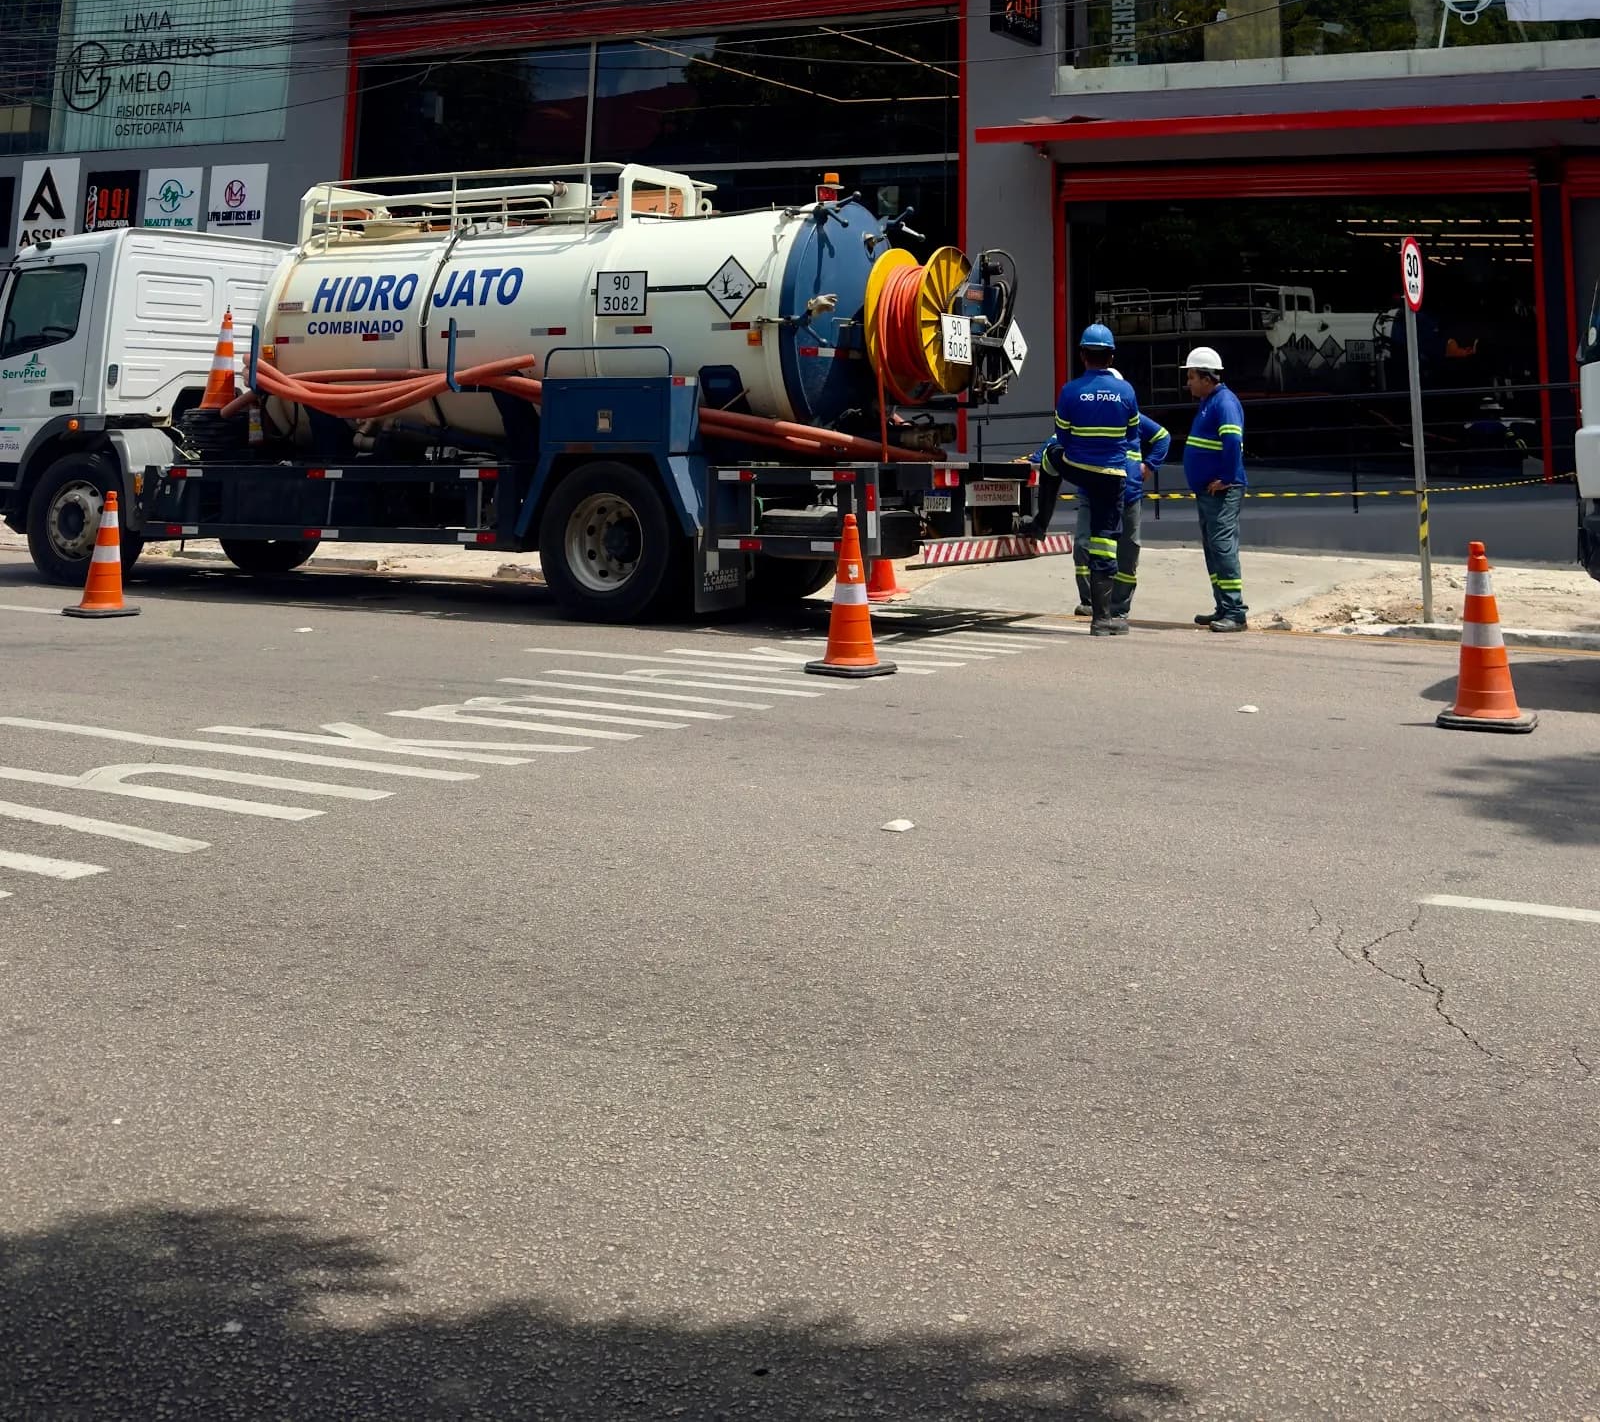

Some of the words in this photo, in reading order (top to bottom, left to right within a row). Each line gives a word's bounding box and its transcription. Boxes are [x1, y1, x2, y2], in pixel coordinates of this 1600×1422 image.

[124, 10, 172, 32] LIVIA
[121, 37, 217, 62] GANTUSS
[119, 70, 172, 94] MELO
[116, 101, 192, 119] FISIOTERAPIA
[115, 121, 185, 137] OSTEOPATIA
[97, 188, 130, 220] 991
[144, 218, 173, 227] BEAUTY
[174, 218, 194, 227] PACK
[1406, 253, 1419, 279] 30
[311, 273, 420, 314] HIDRO
[433, 267, 525, 308] JATO
[613, 275, 631, 291] 90
[603, 296, 639, 311] 3082
[307, 319, 404, 335] COMBINADO
[951, 320, 963, 336] 90
[948, 341, 969, 359] 3082
[2, 367, 47, 379] ServPred
[1096, 393, 1121, 403] PARÁ
[973, 483, 1013, 492] MANTENHA
